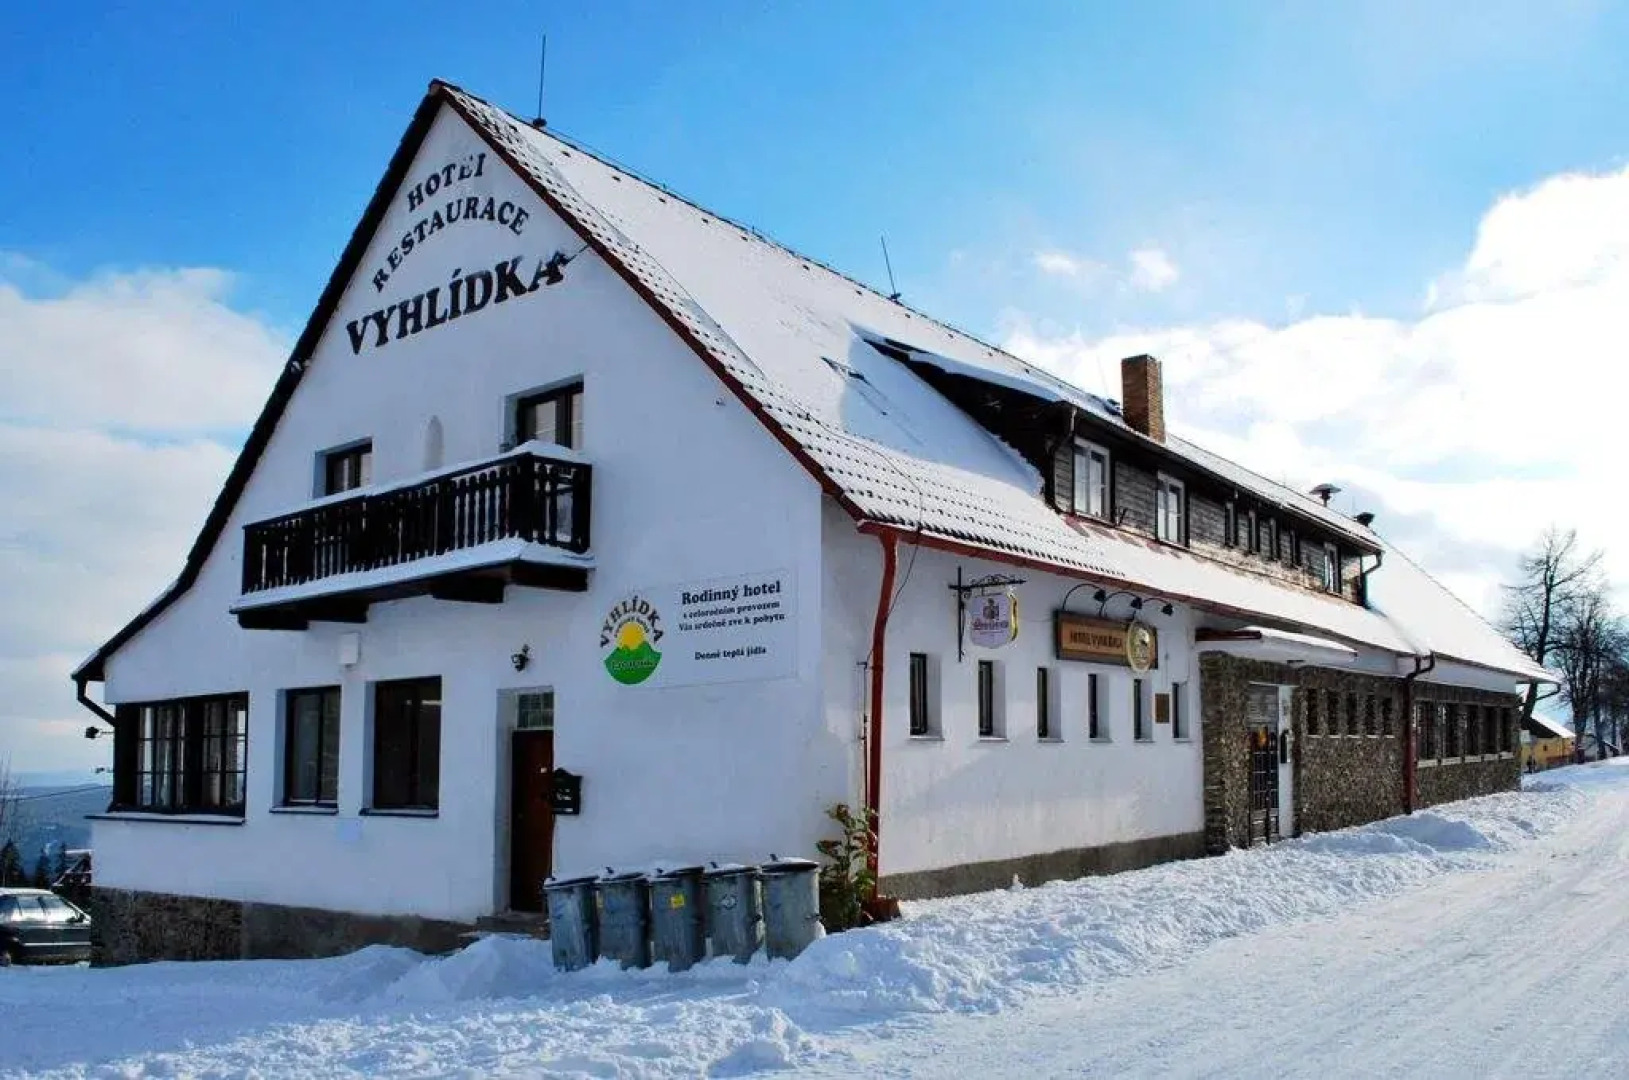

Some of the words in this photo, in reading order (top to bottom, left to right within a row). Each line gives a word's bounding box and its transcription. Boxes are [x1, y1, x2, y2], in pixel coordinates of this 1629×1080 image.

[372, 196, 529, 293] RESTAURACE
[346, 251, 566, 355] VYHLÍDKA
[682, 585, 739, 605] Rodinný
[743, 580, 780, 597] hotel
[737, 601, 780, 615] provozem
[600, 595, 664, 648] VYHLÍDKA
[728, 619, 743, 628] zve
[745, 616, 752, 624] k
[754, 613, 785, 626] pobytu
